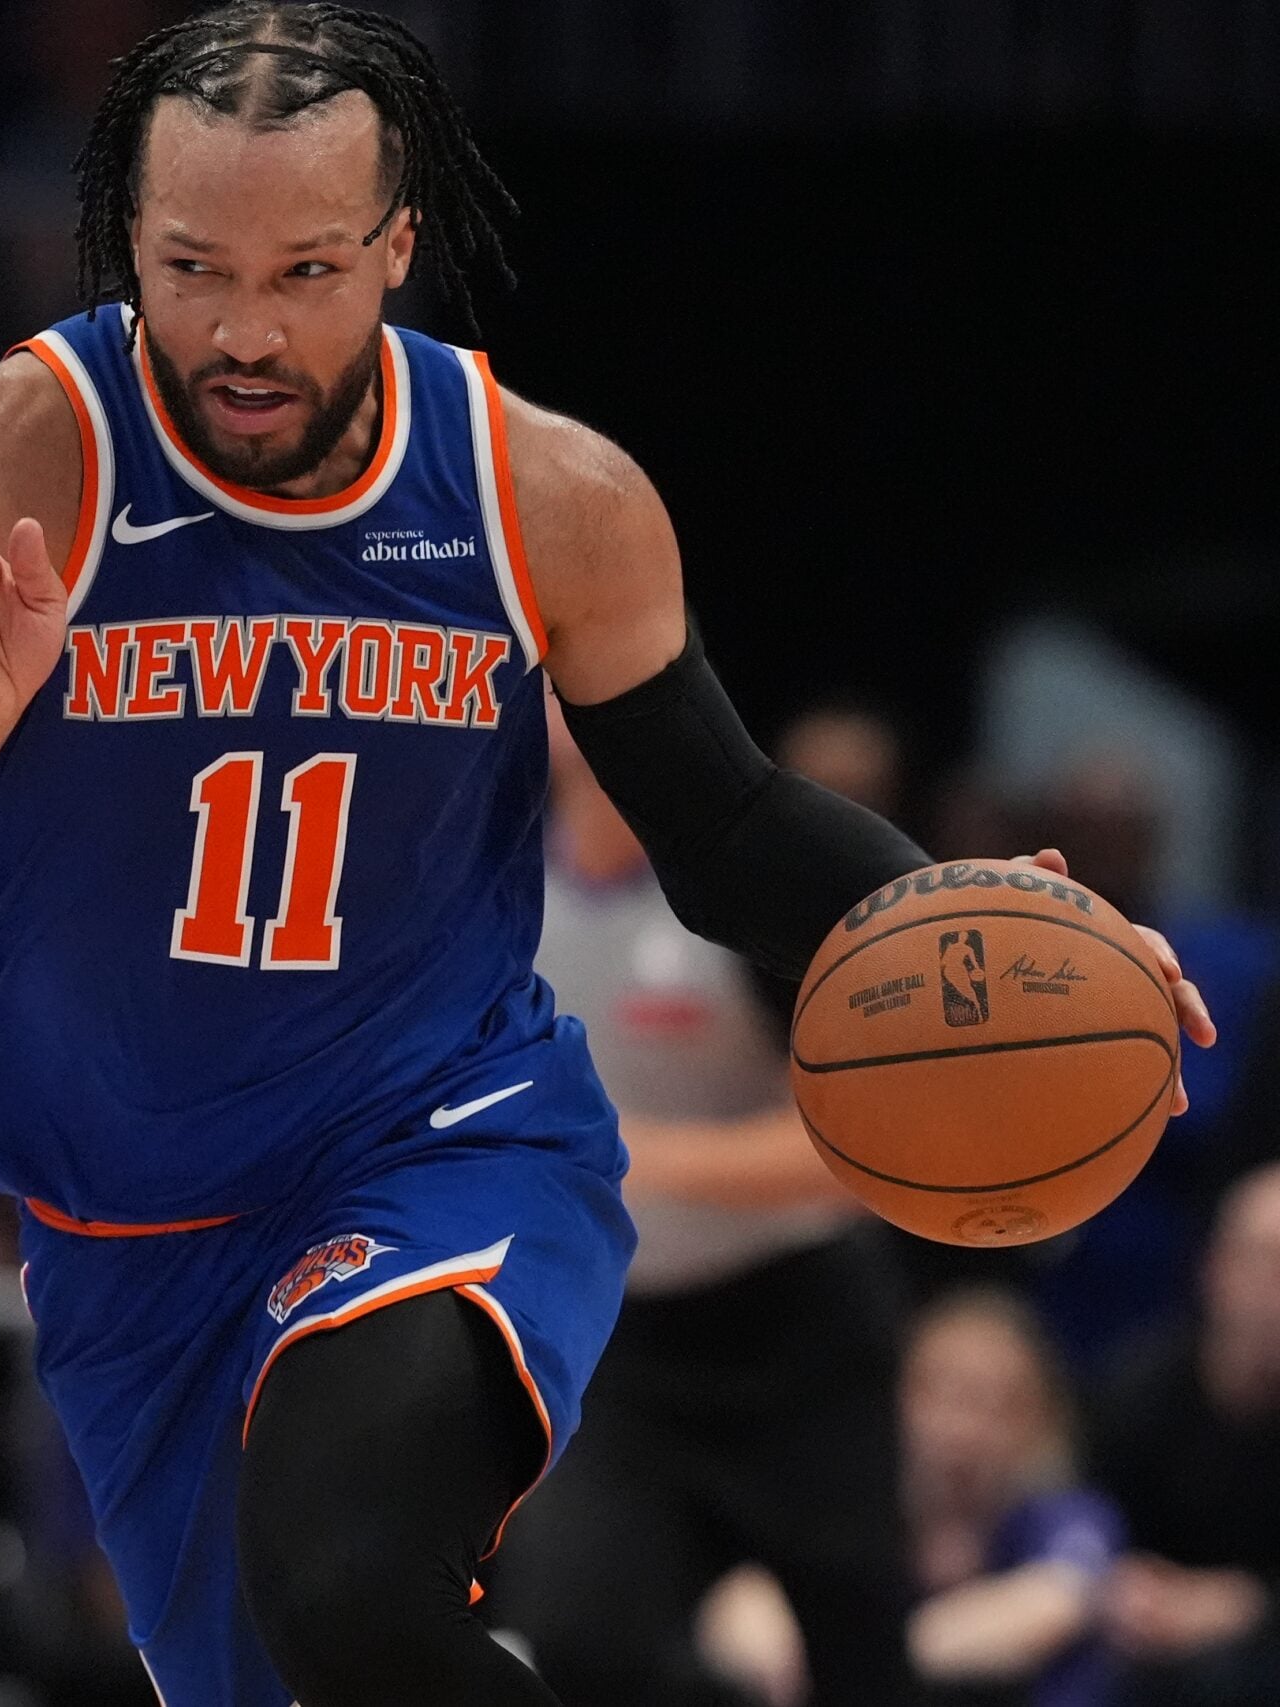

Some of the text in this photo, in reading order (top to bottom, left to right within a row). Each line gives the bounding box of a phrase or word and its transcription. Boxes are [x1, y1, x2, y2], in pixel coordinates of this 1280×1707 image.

[362, 541, 407, 562] abu
[364, 529, 424, 541] experience
[63, 614, 512, 730] NEW YORK
[169, 750, 358, 971] 11
[845, 863, 1093, 932] Wilson
